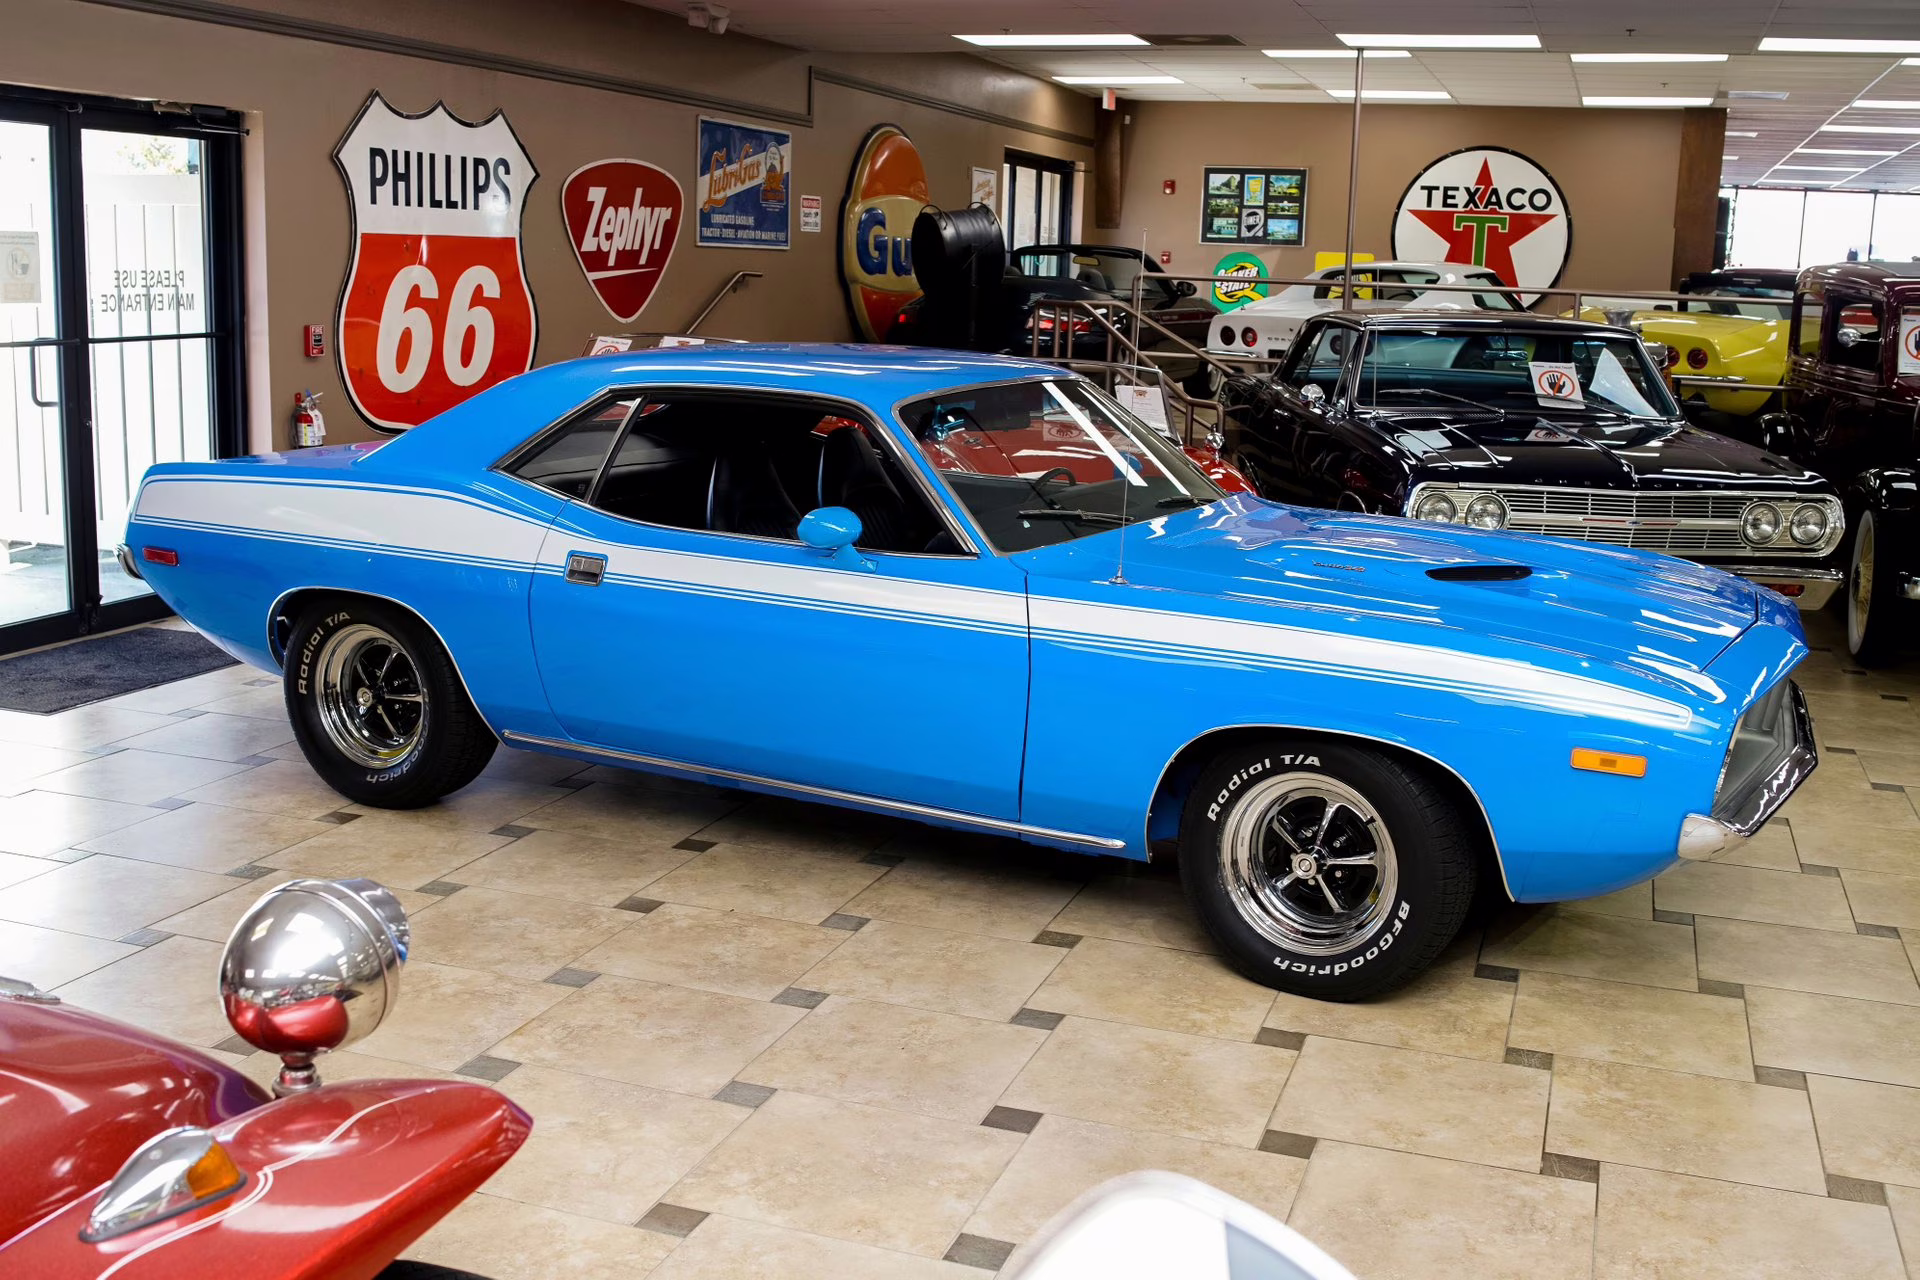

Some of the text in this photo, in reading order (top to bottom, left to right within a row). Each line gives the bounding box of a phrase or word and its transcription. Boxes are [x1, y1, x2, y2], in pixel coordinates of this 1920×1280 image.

[369, 147, 511, 212] PHILLIPS
[1420, 185, 1552, 212] TEXACO
[580, 186, 672, 267] Zephyr
[711, 213, 754, 226] LUBRICATED GASOLINE
[856, 207, 913, 277] Gu
[1216, 266, 1258, 285] QAKER
[376, 264, 500, 394] 66
[298, 611, 351, 695] Radial T/A
[1207, 754, 1321, 821] Radial T/A
[1273, 900, 1411, 976] BFGoodrich
